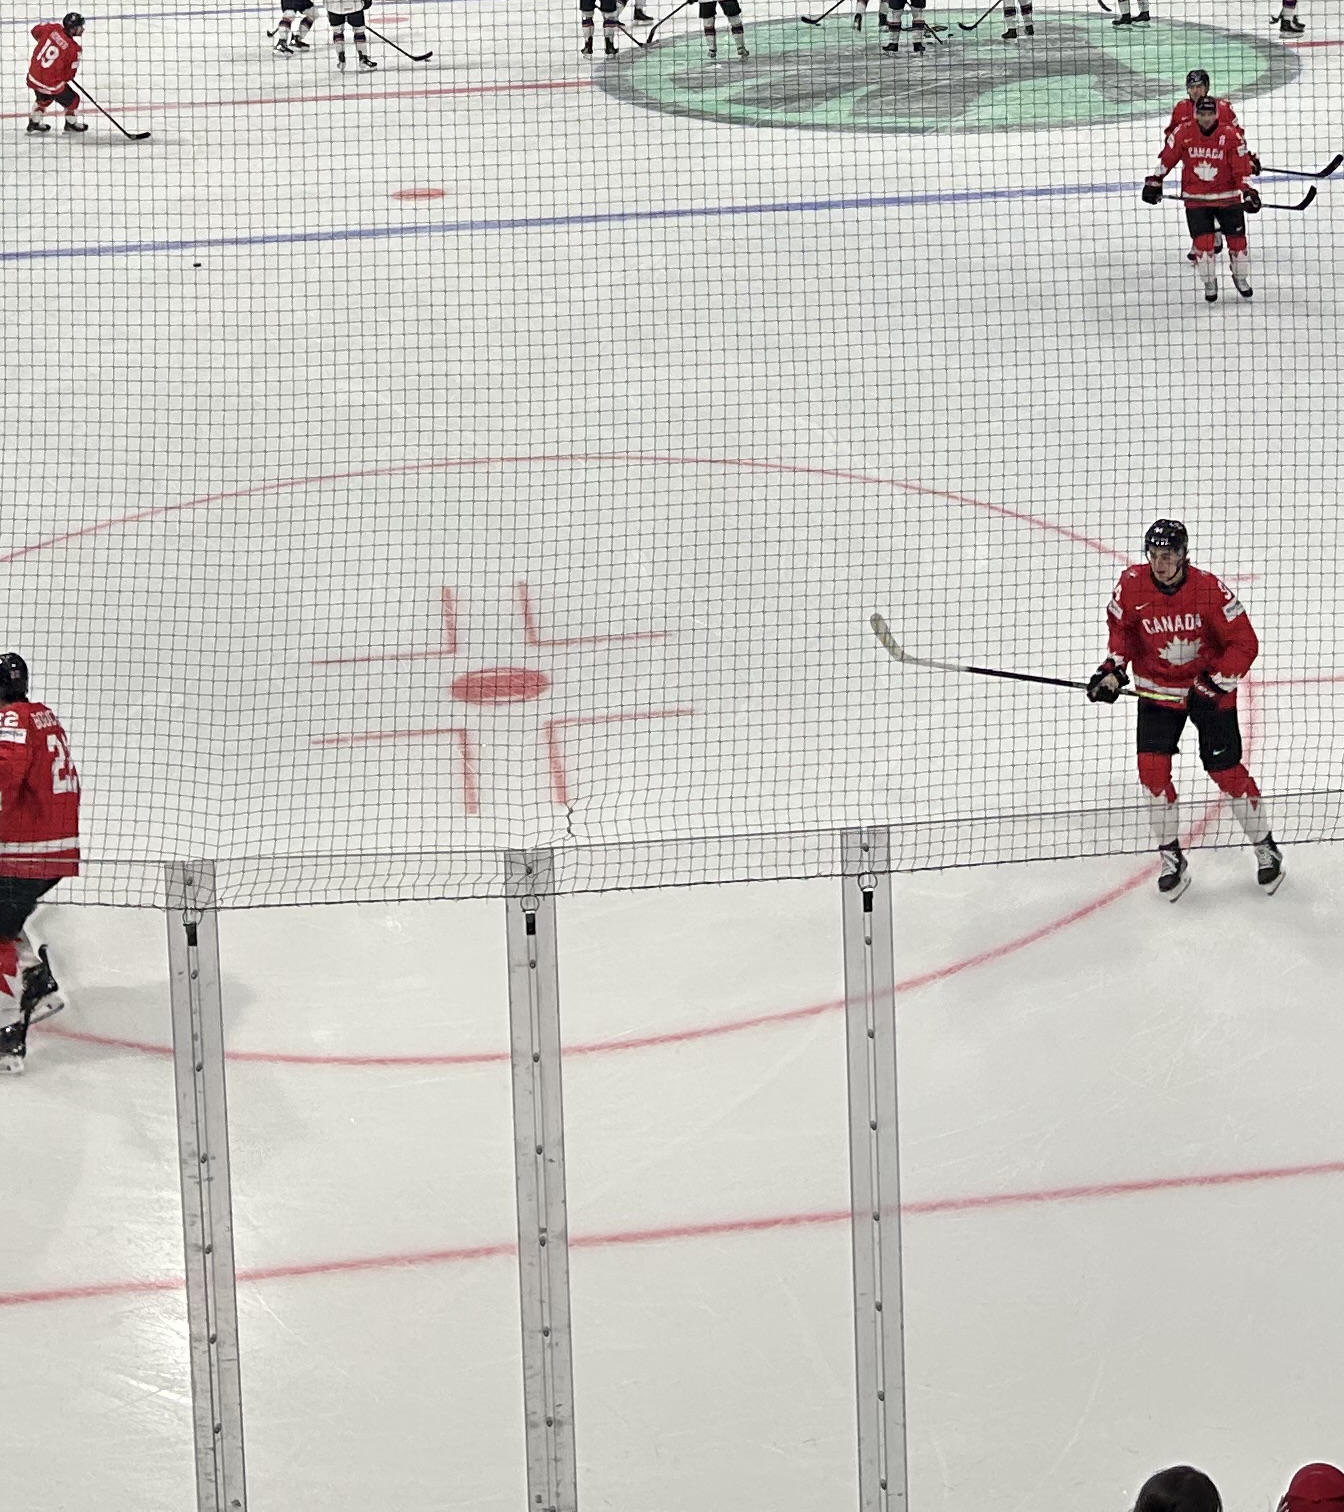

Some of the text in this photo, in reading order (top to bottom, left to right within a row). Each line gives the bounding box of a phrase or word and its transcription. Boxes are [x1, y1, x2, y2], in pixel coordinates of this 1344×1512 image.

[36, 37, 60, 69] 19
[1141, 612, 1203, 635] CANADA
[46, 733, 79, 795] 2
